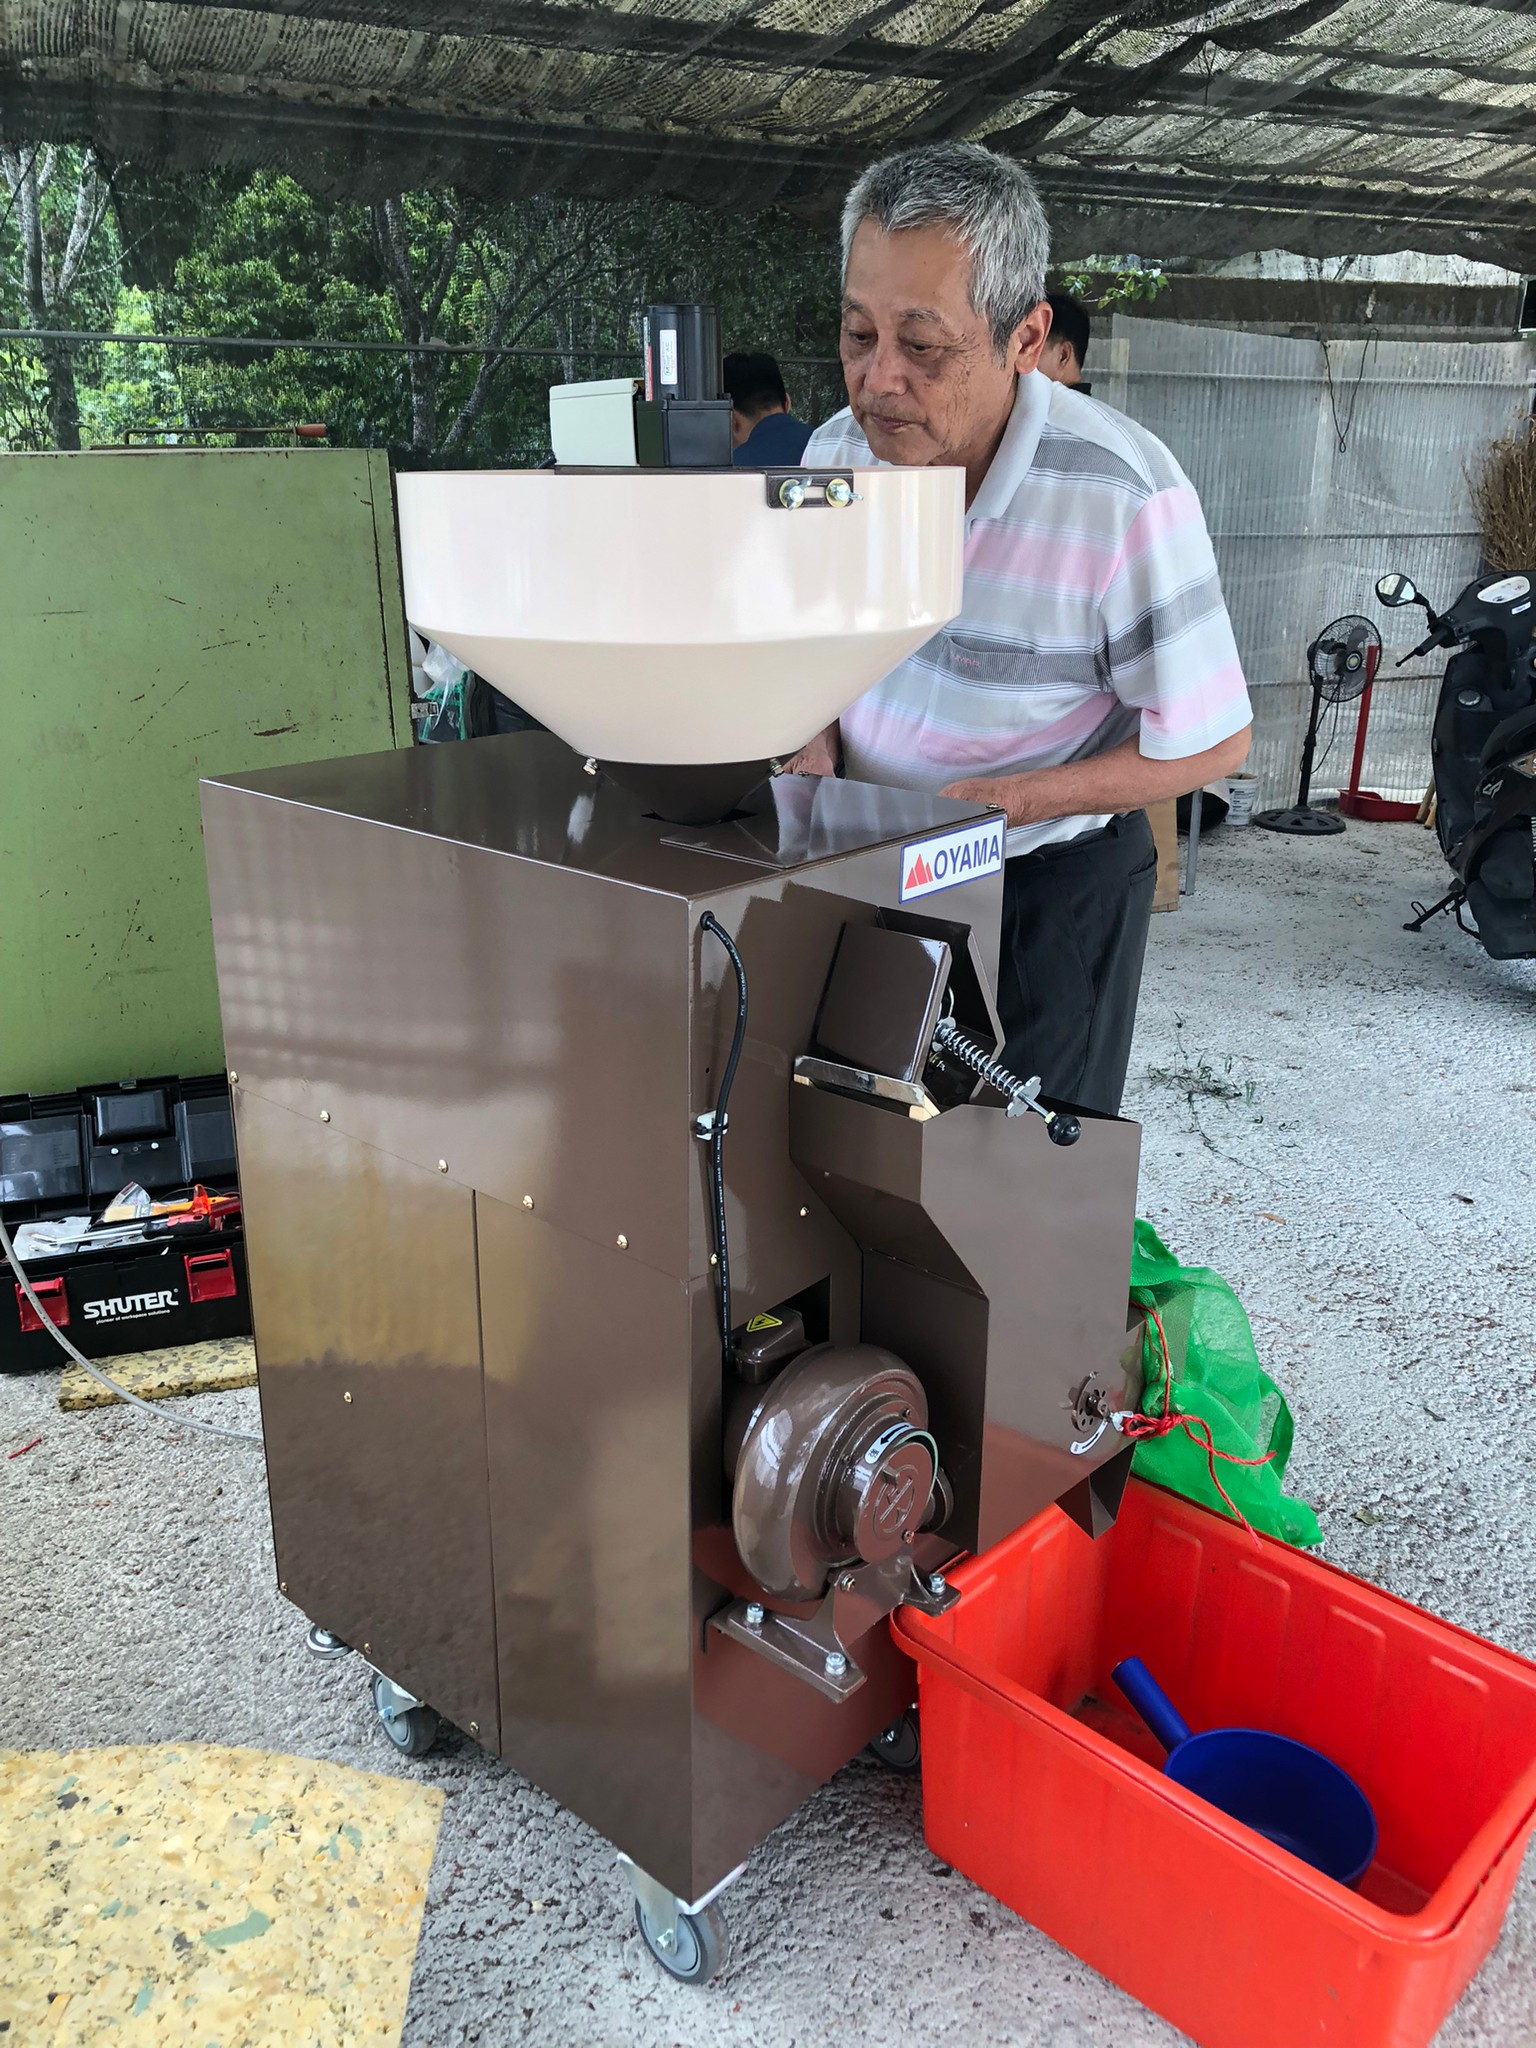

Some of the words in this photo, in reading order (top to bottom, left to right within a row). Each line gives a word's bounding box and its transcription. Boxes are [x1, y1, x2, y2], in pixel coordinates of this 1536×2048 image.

[933, 834, 1000, 880] OYAMA
[83, 1290, 178, 1319] SHUTER
[96, 1317, 115, 1325] pioneer
[121, 1312, 147, 1321] workspace
